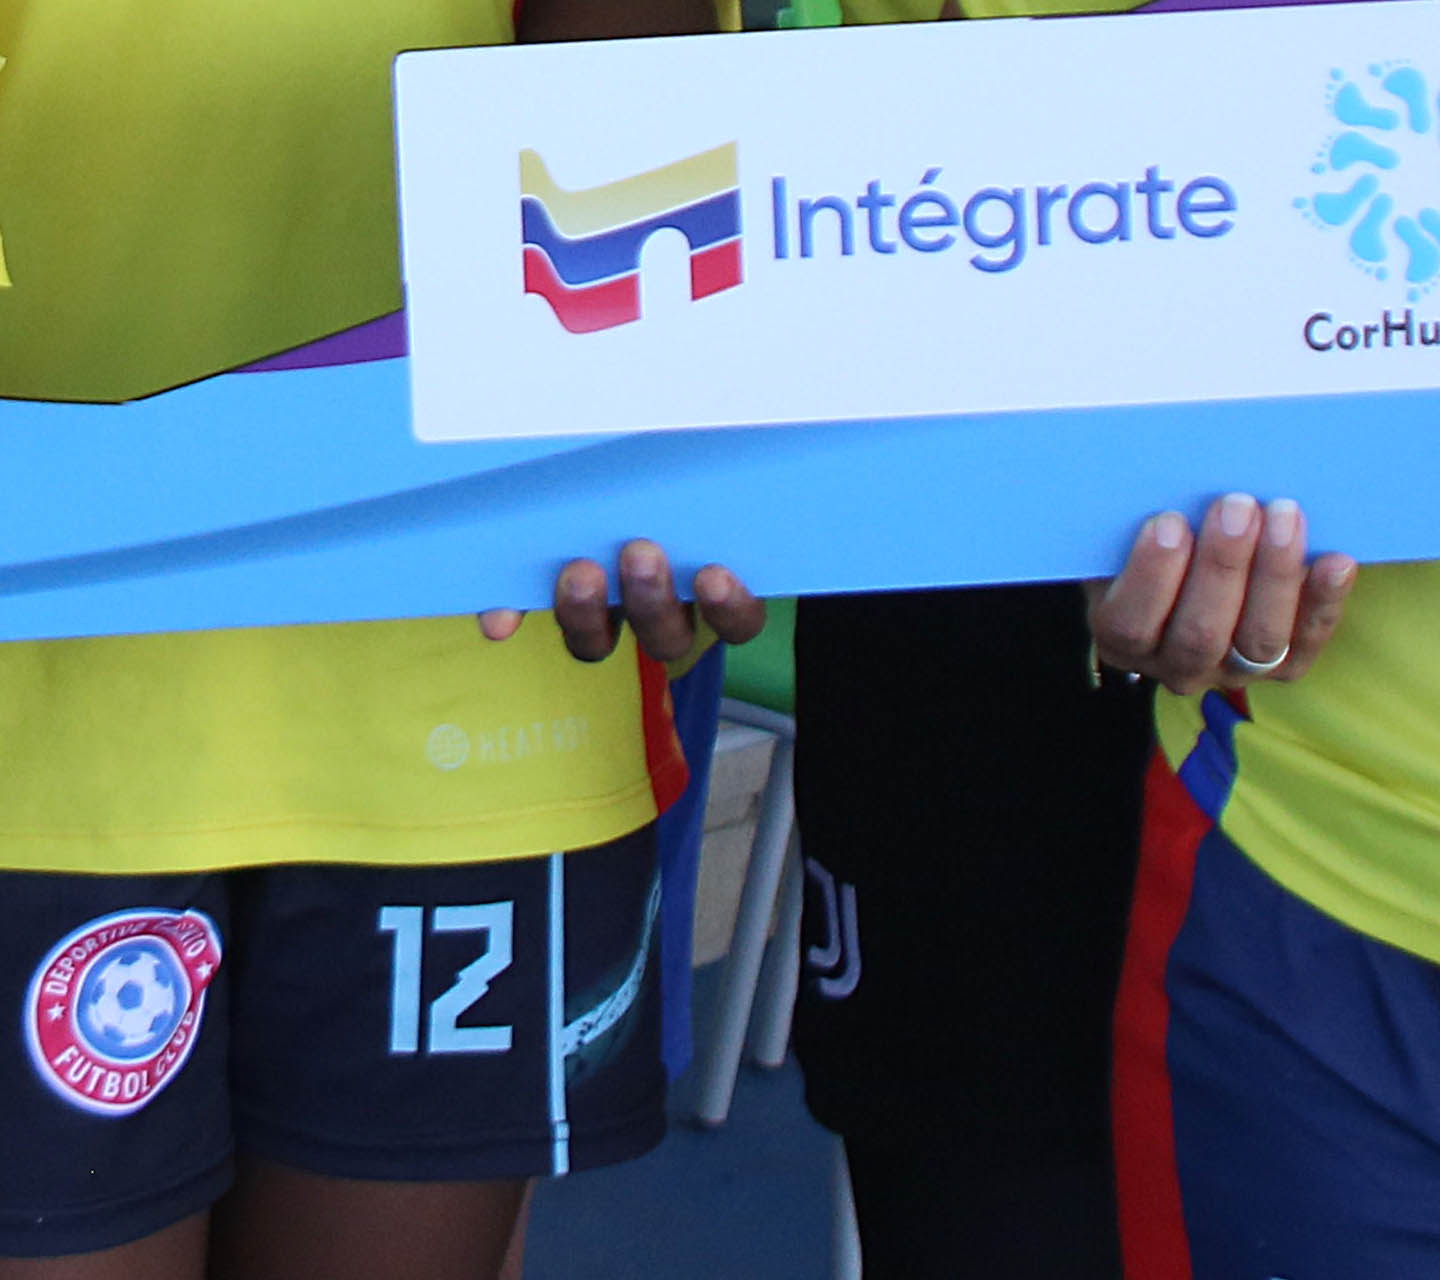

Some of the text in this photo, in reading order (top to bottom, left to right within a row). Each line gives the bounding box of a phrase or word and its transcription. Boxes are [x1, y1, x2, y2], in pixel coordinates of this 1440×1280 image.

[771, 165, 1238, 275] Intégrate
[379, 901, 515, 1055] 12
[53, 1045, 152, 1099] FUTBOL
